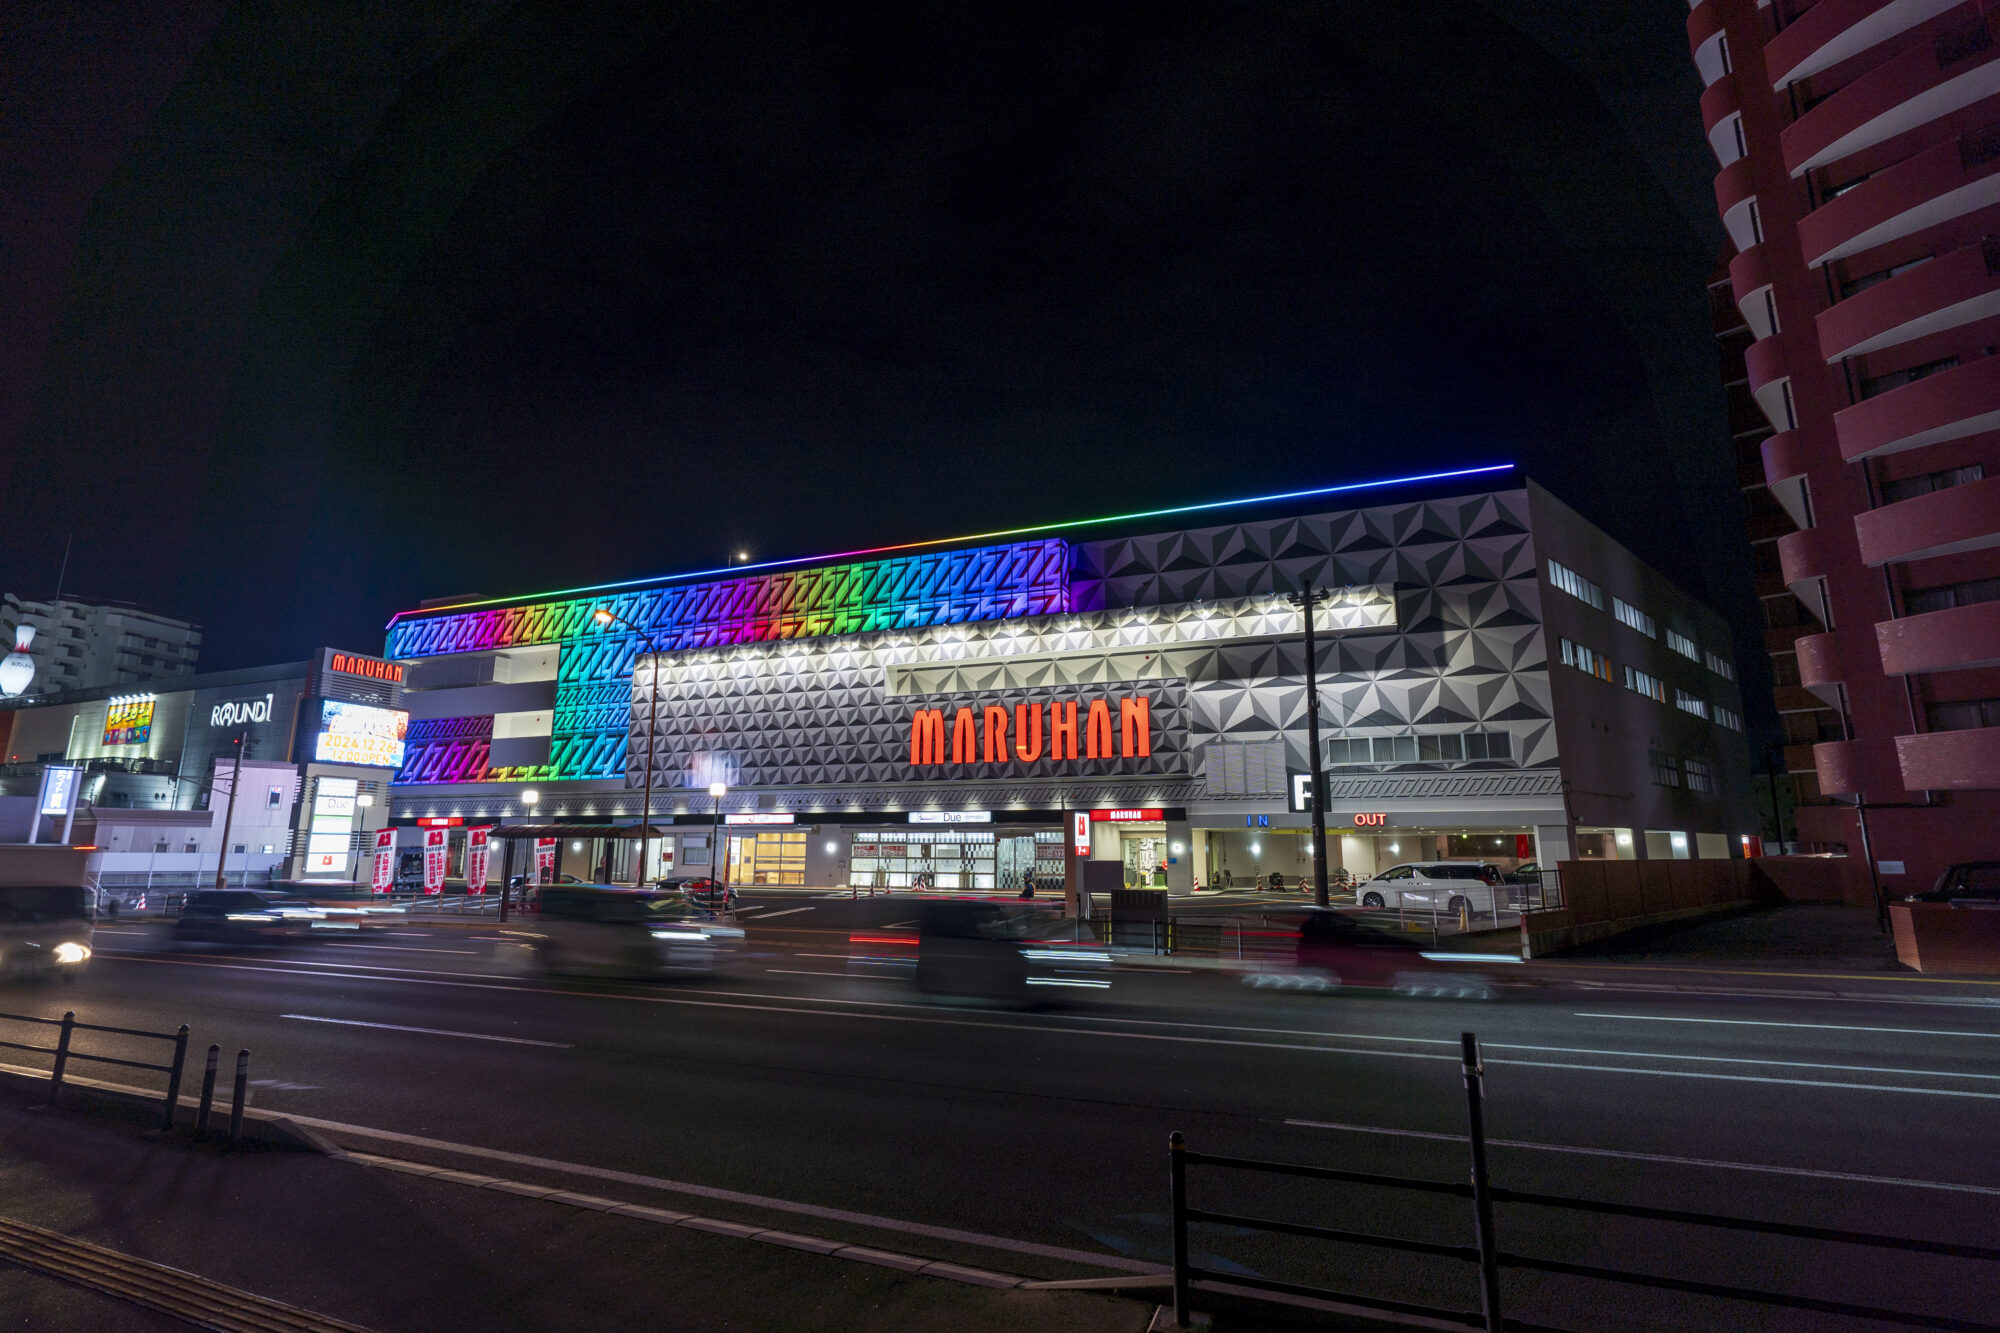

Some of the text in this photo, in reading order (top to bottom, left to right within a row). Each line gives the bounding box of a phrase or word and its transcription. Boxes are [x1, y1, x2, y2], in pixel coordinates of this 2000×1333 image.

[331, 653, 404, 682] MARUHAN
[909, 695, 1151, 766] MARUHAN
[943, 812, 962, 822] Due
[1354, 812, 1387, 827] OUT
